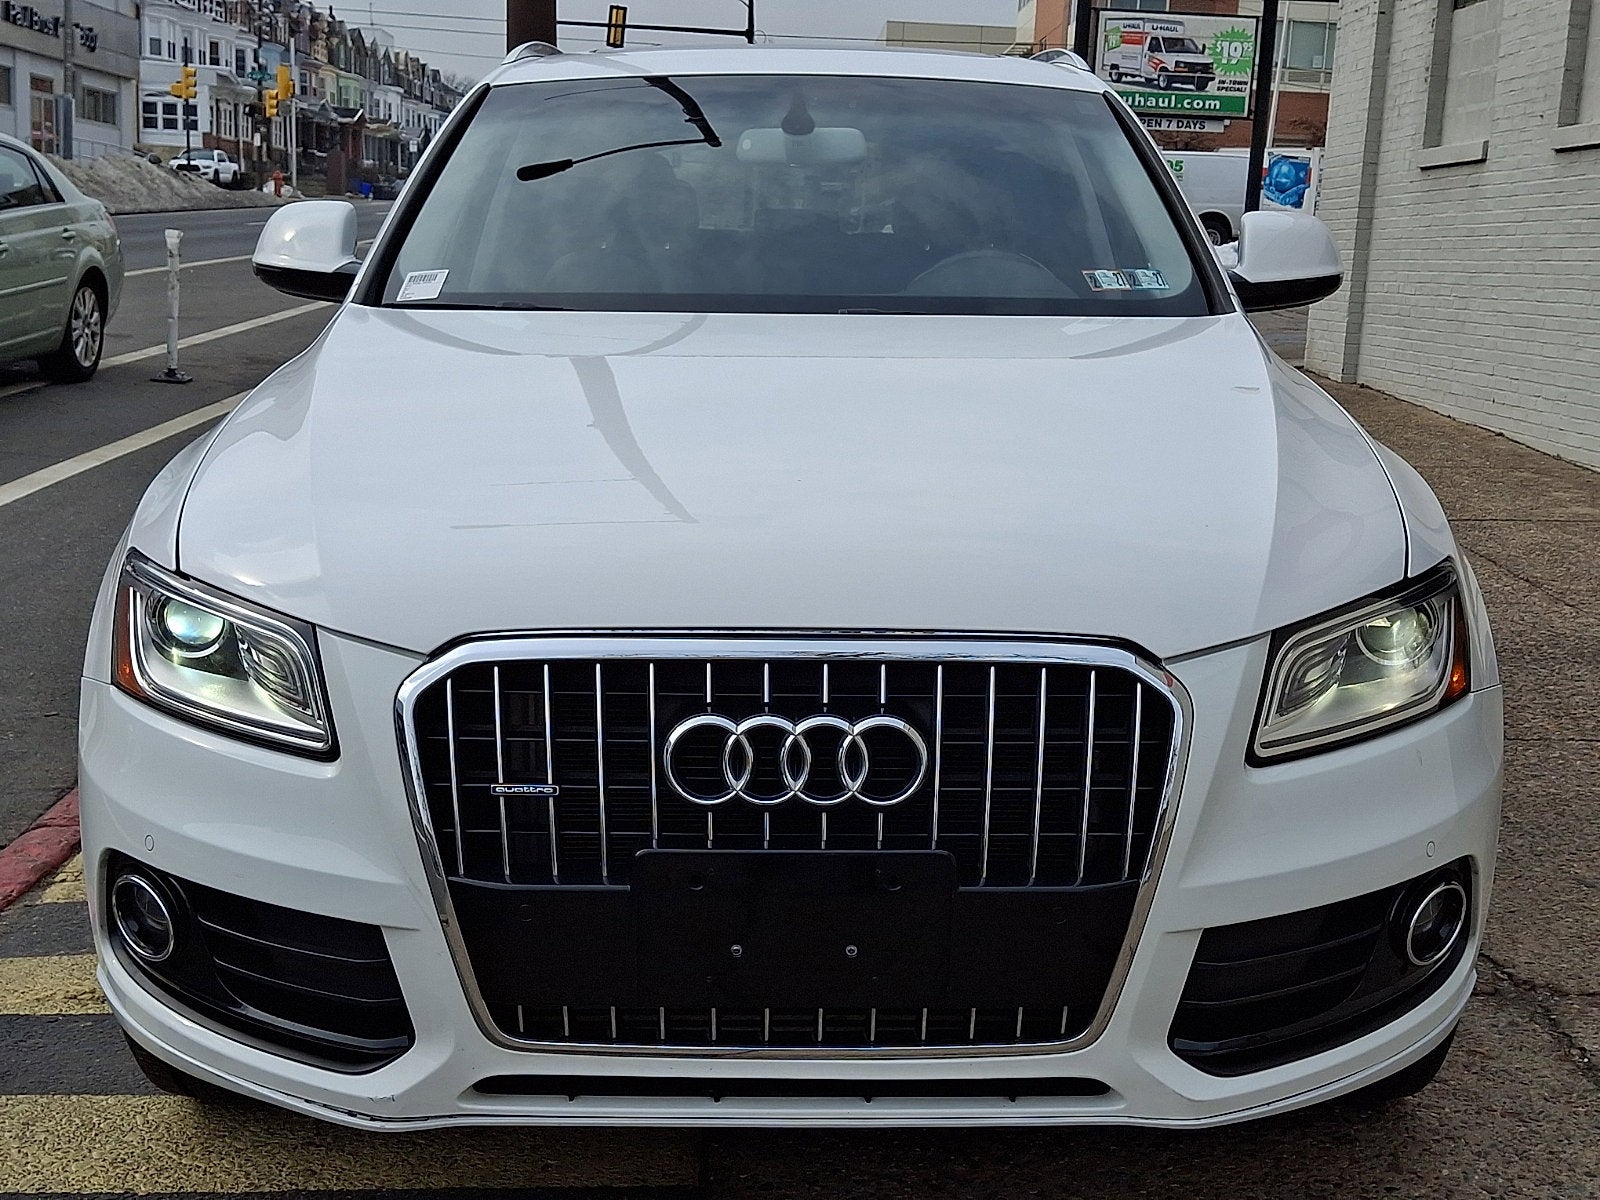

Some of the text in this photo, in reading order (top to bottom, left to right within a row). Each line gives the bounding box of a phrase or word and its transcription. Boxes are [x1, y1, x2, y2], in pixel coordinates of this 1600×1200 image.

[1152, 24, 1179, 33] U-HAUL
[1123, 93, 1220, 109] uhaul.com
[1166, 120, 1173, 129] 7
[1176, 120, 1206, 130] DAYS
